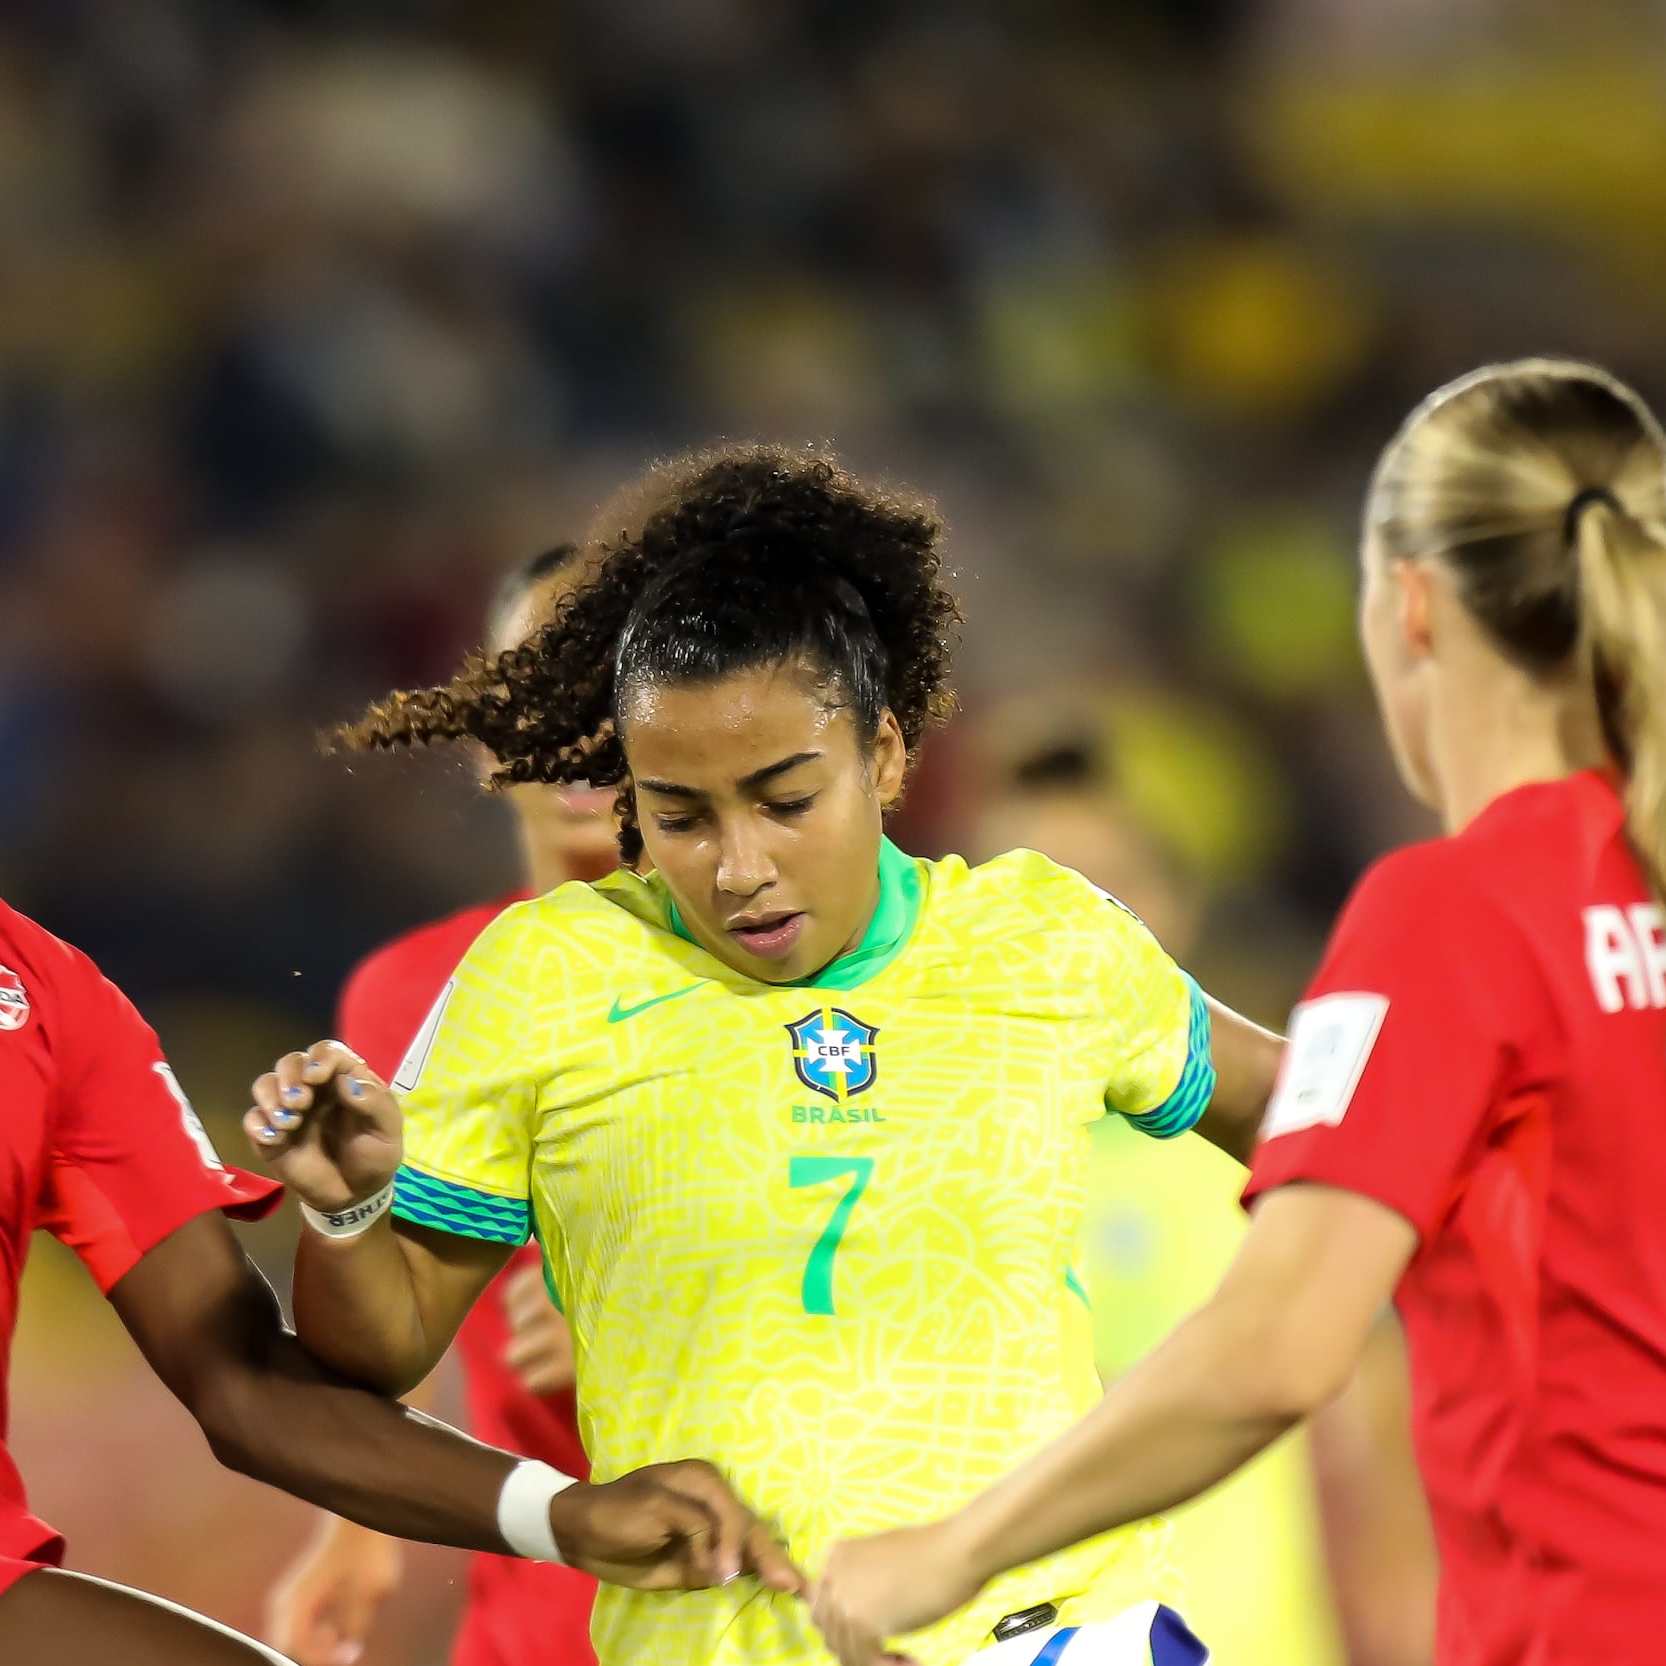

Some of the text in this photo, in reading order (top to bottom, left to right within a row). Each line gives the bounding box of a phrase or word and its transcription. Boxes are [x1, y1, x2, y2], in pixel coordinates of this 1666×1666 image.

[818, 1046, 850, 1056] CBF
[792, 1105, 886, 1124] BRASIL
[789, 1157, 874, 1315] 7
